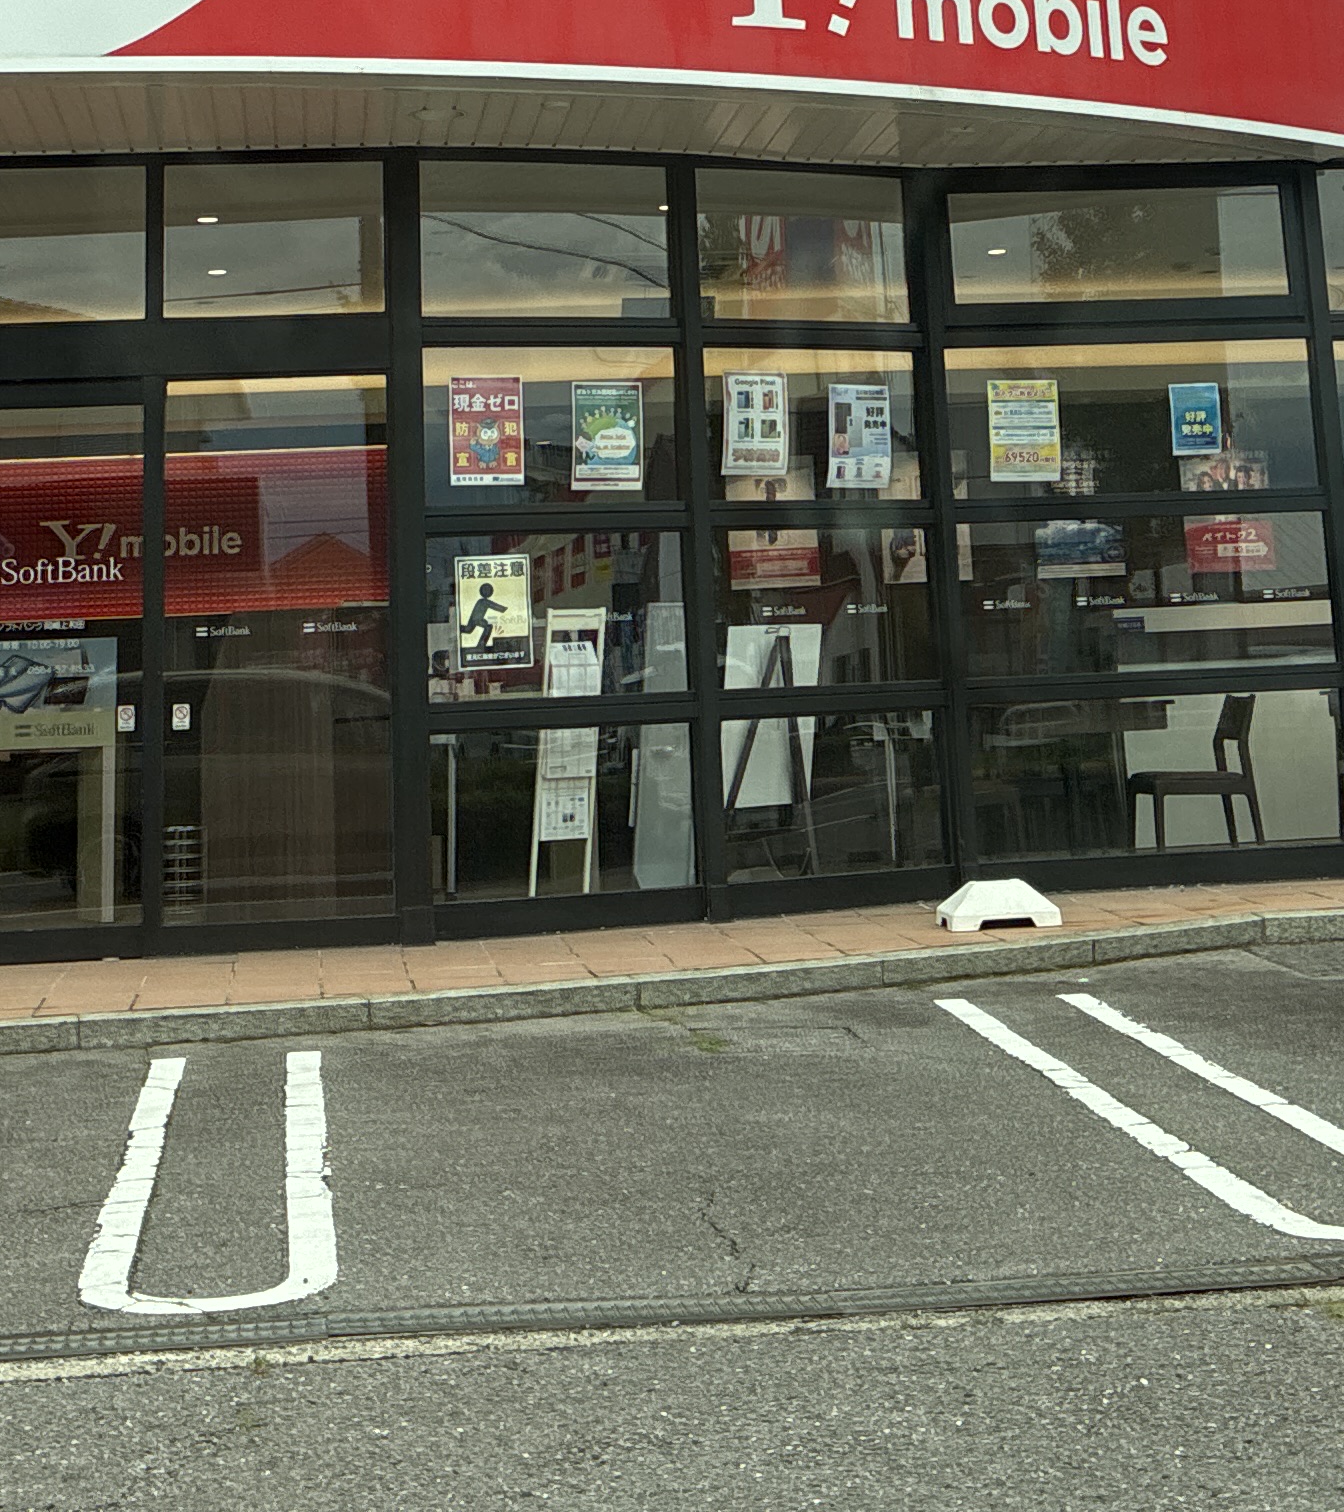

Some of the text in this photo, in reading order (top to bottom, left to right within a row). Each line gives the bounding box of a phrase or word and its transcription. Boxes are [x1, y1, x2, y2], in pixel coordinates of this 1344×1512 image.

[453, 393, 519, 412] 現金ゼロ
[0, 555, 124, 586] SoftBank
[460, 560, 525, 579] 段差注意
